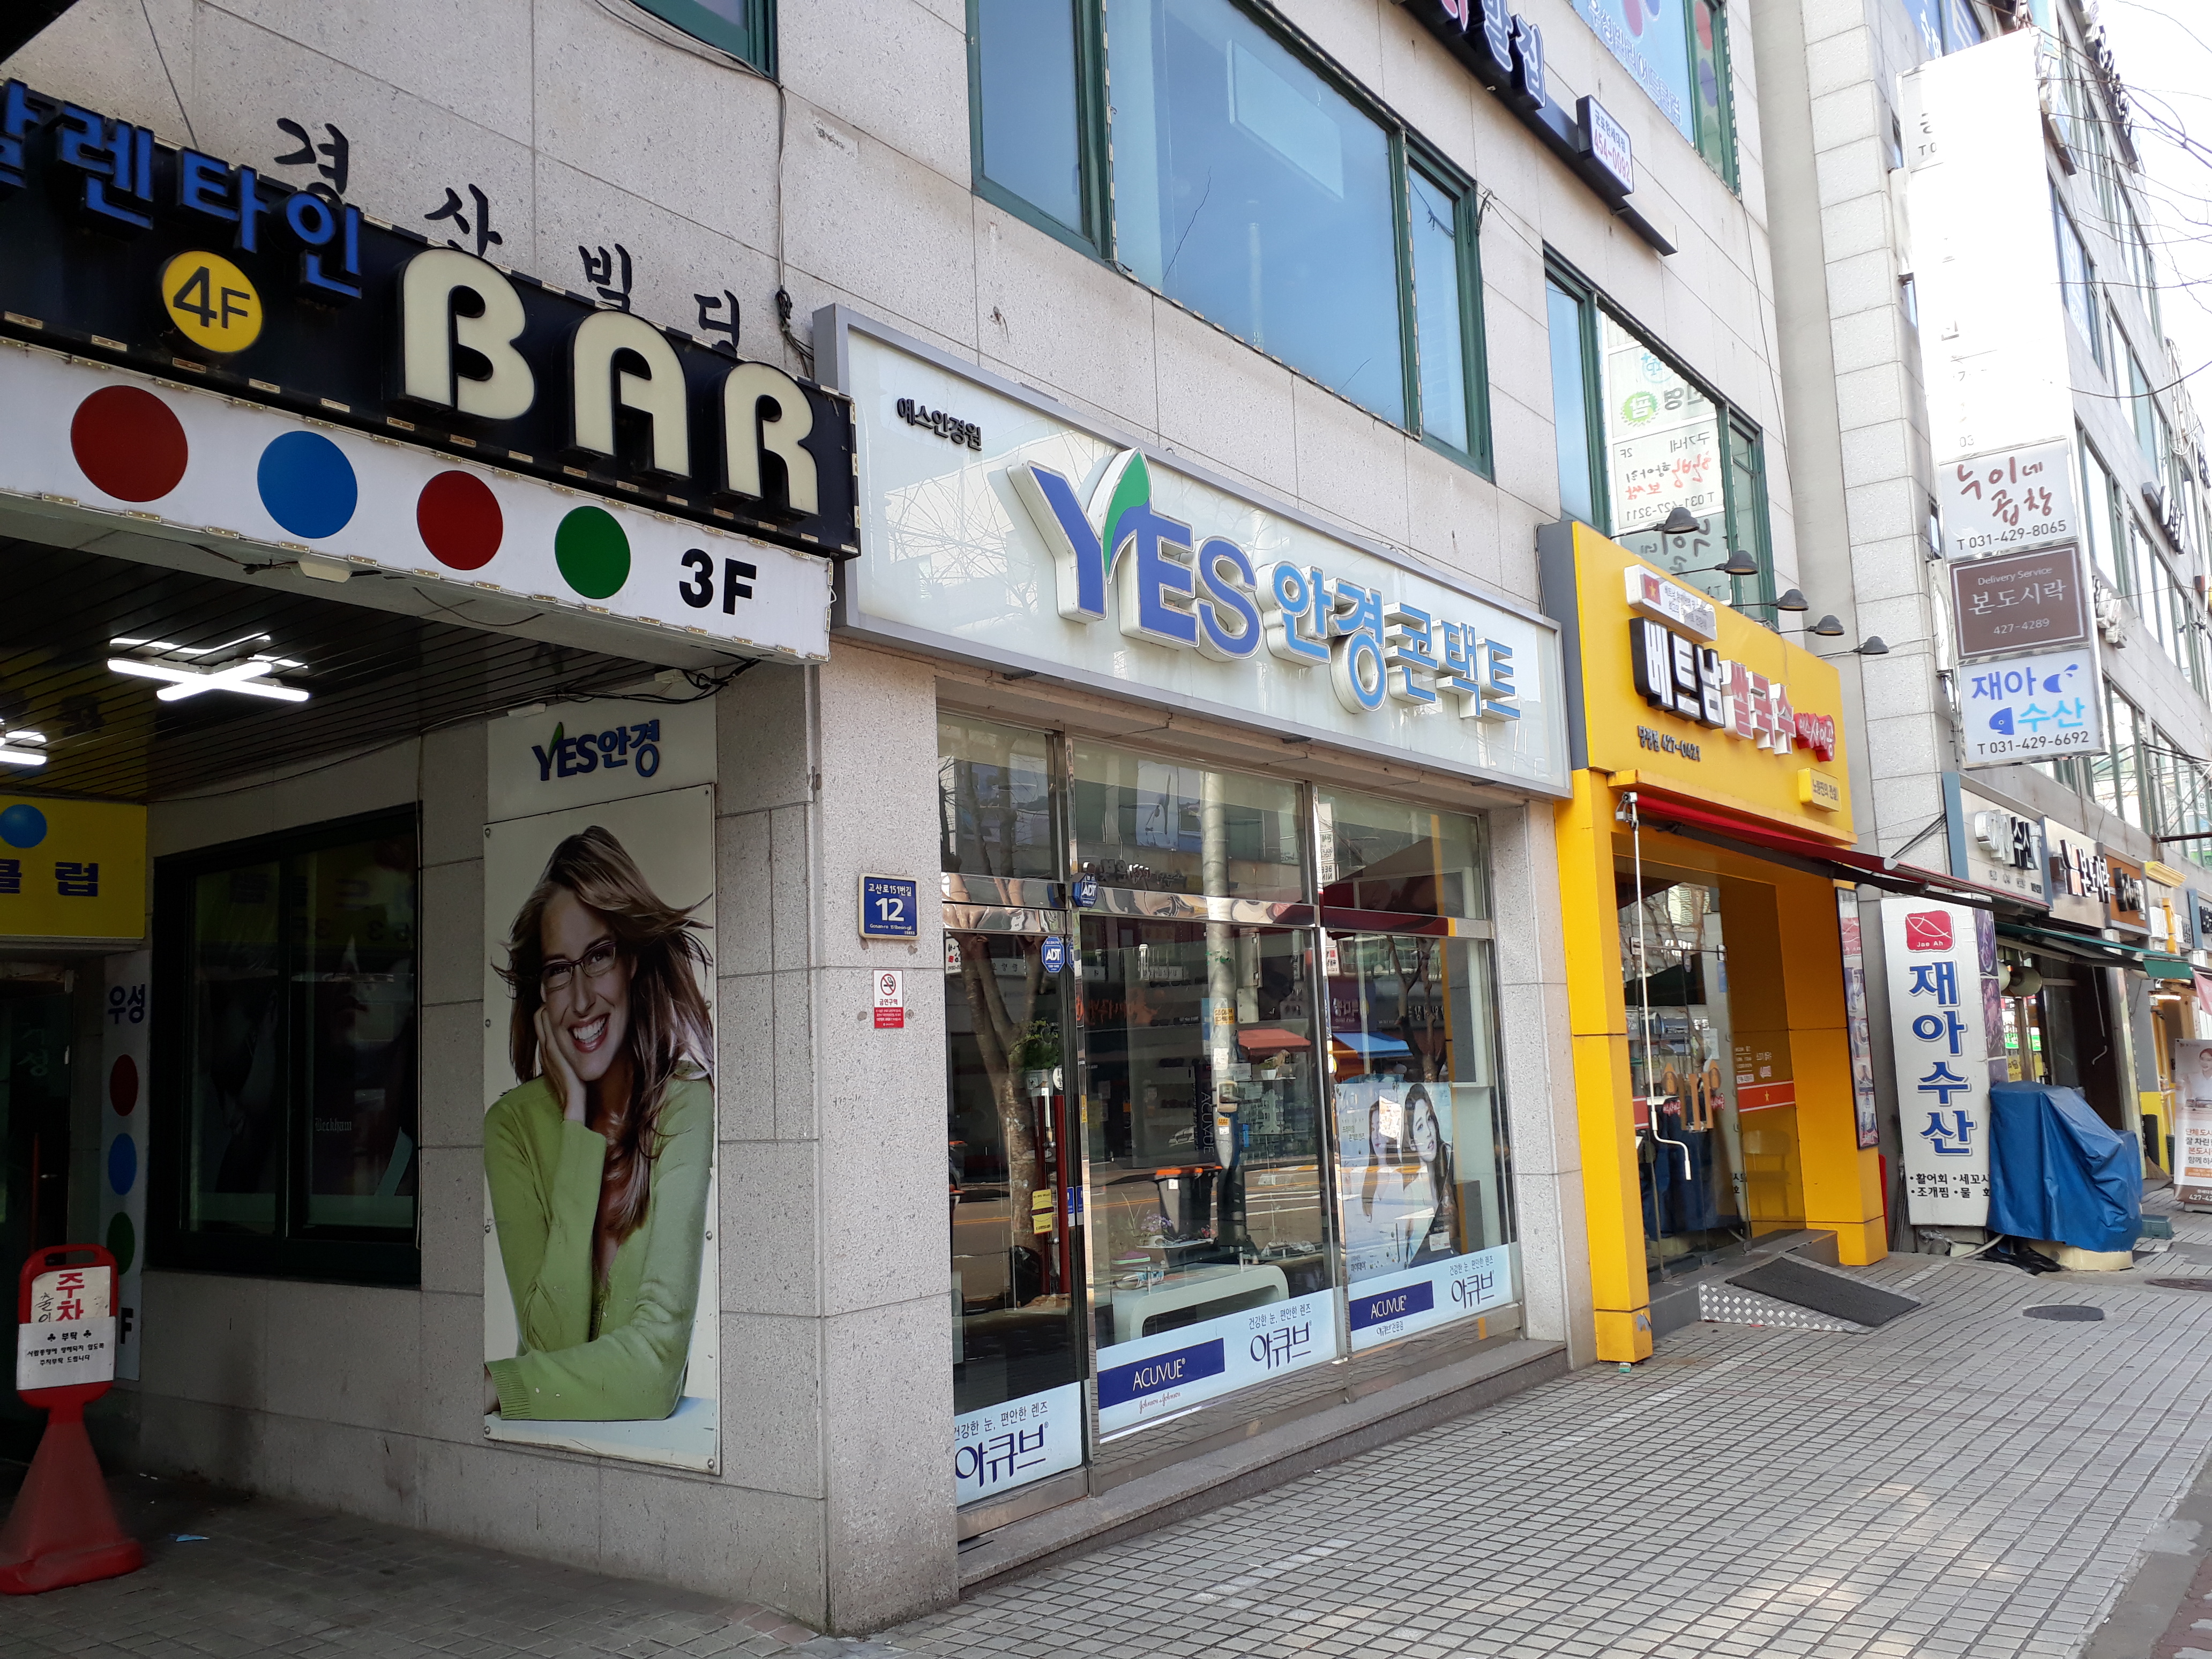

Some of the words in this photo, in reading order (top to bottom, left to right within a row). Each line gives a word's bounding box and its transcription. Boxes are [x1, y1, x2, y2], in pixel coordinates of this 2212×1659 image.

[173, 266, 251, 329] 4F
[403, 246, 820, 516] BAR
[1991, 486, 2052, 526] 곱창
[1969, 520, 2067, 548] 031-429-8065
[679, 548, 757, 616] 3F
[1977, 571, 2016, 587] Delivery
[2017, 565, 2053, 580] Service
[1968, 578, 2067, 616] 본도시락
[1993, 618, 2050, 636] 427-4289
[1971, 667, 2037, 701] 재아
[2017, 697, 2087, 733] 수산
[1989, 730, 2090, 754] 031-429-6692
[868, 882, 912, 897] 고산로151번길
[1081, 884, 1097, 896] ADT
[875, 897, 905, 922] 12
[1045, 948, 1061, 961] ADT
[108, 983, 146, 1025] 우성
[1908, 960, 1976, 1156] 재아수산
[1200, 1091, 1215, 1156] ACUVUE
[2188, 1147, 2212, 1155] 본도시
[1916, 1173, 1948, 1185] 활어회
[1917, 1186, 1949, 1199] 조개찜
[1249, 1314, 1267, 1330] 건강한
[1280, 1305, 1298, 1322] 편안한
[1299, 1303, 1312, 1316] 렌즈
[1370, 1295, 1408, 1320] ACUVUE
[62, 1332, 78, 1342] 부탁
[1250, 1321, 1312, 1370] 아큐브
[1133, 1358, 1185, 1392] ACUVUE
[1000, 1406, 1027, 1427] 편안한
[1031, 1401, 1048, 1418] 렌즈
[955, 1423, 1047, 1488] 아큐브
